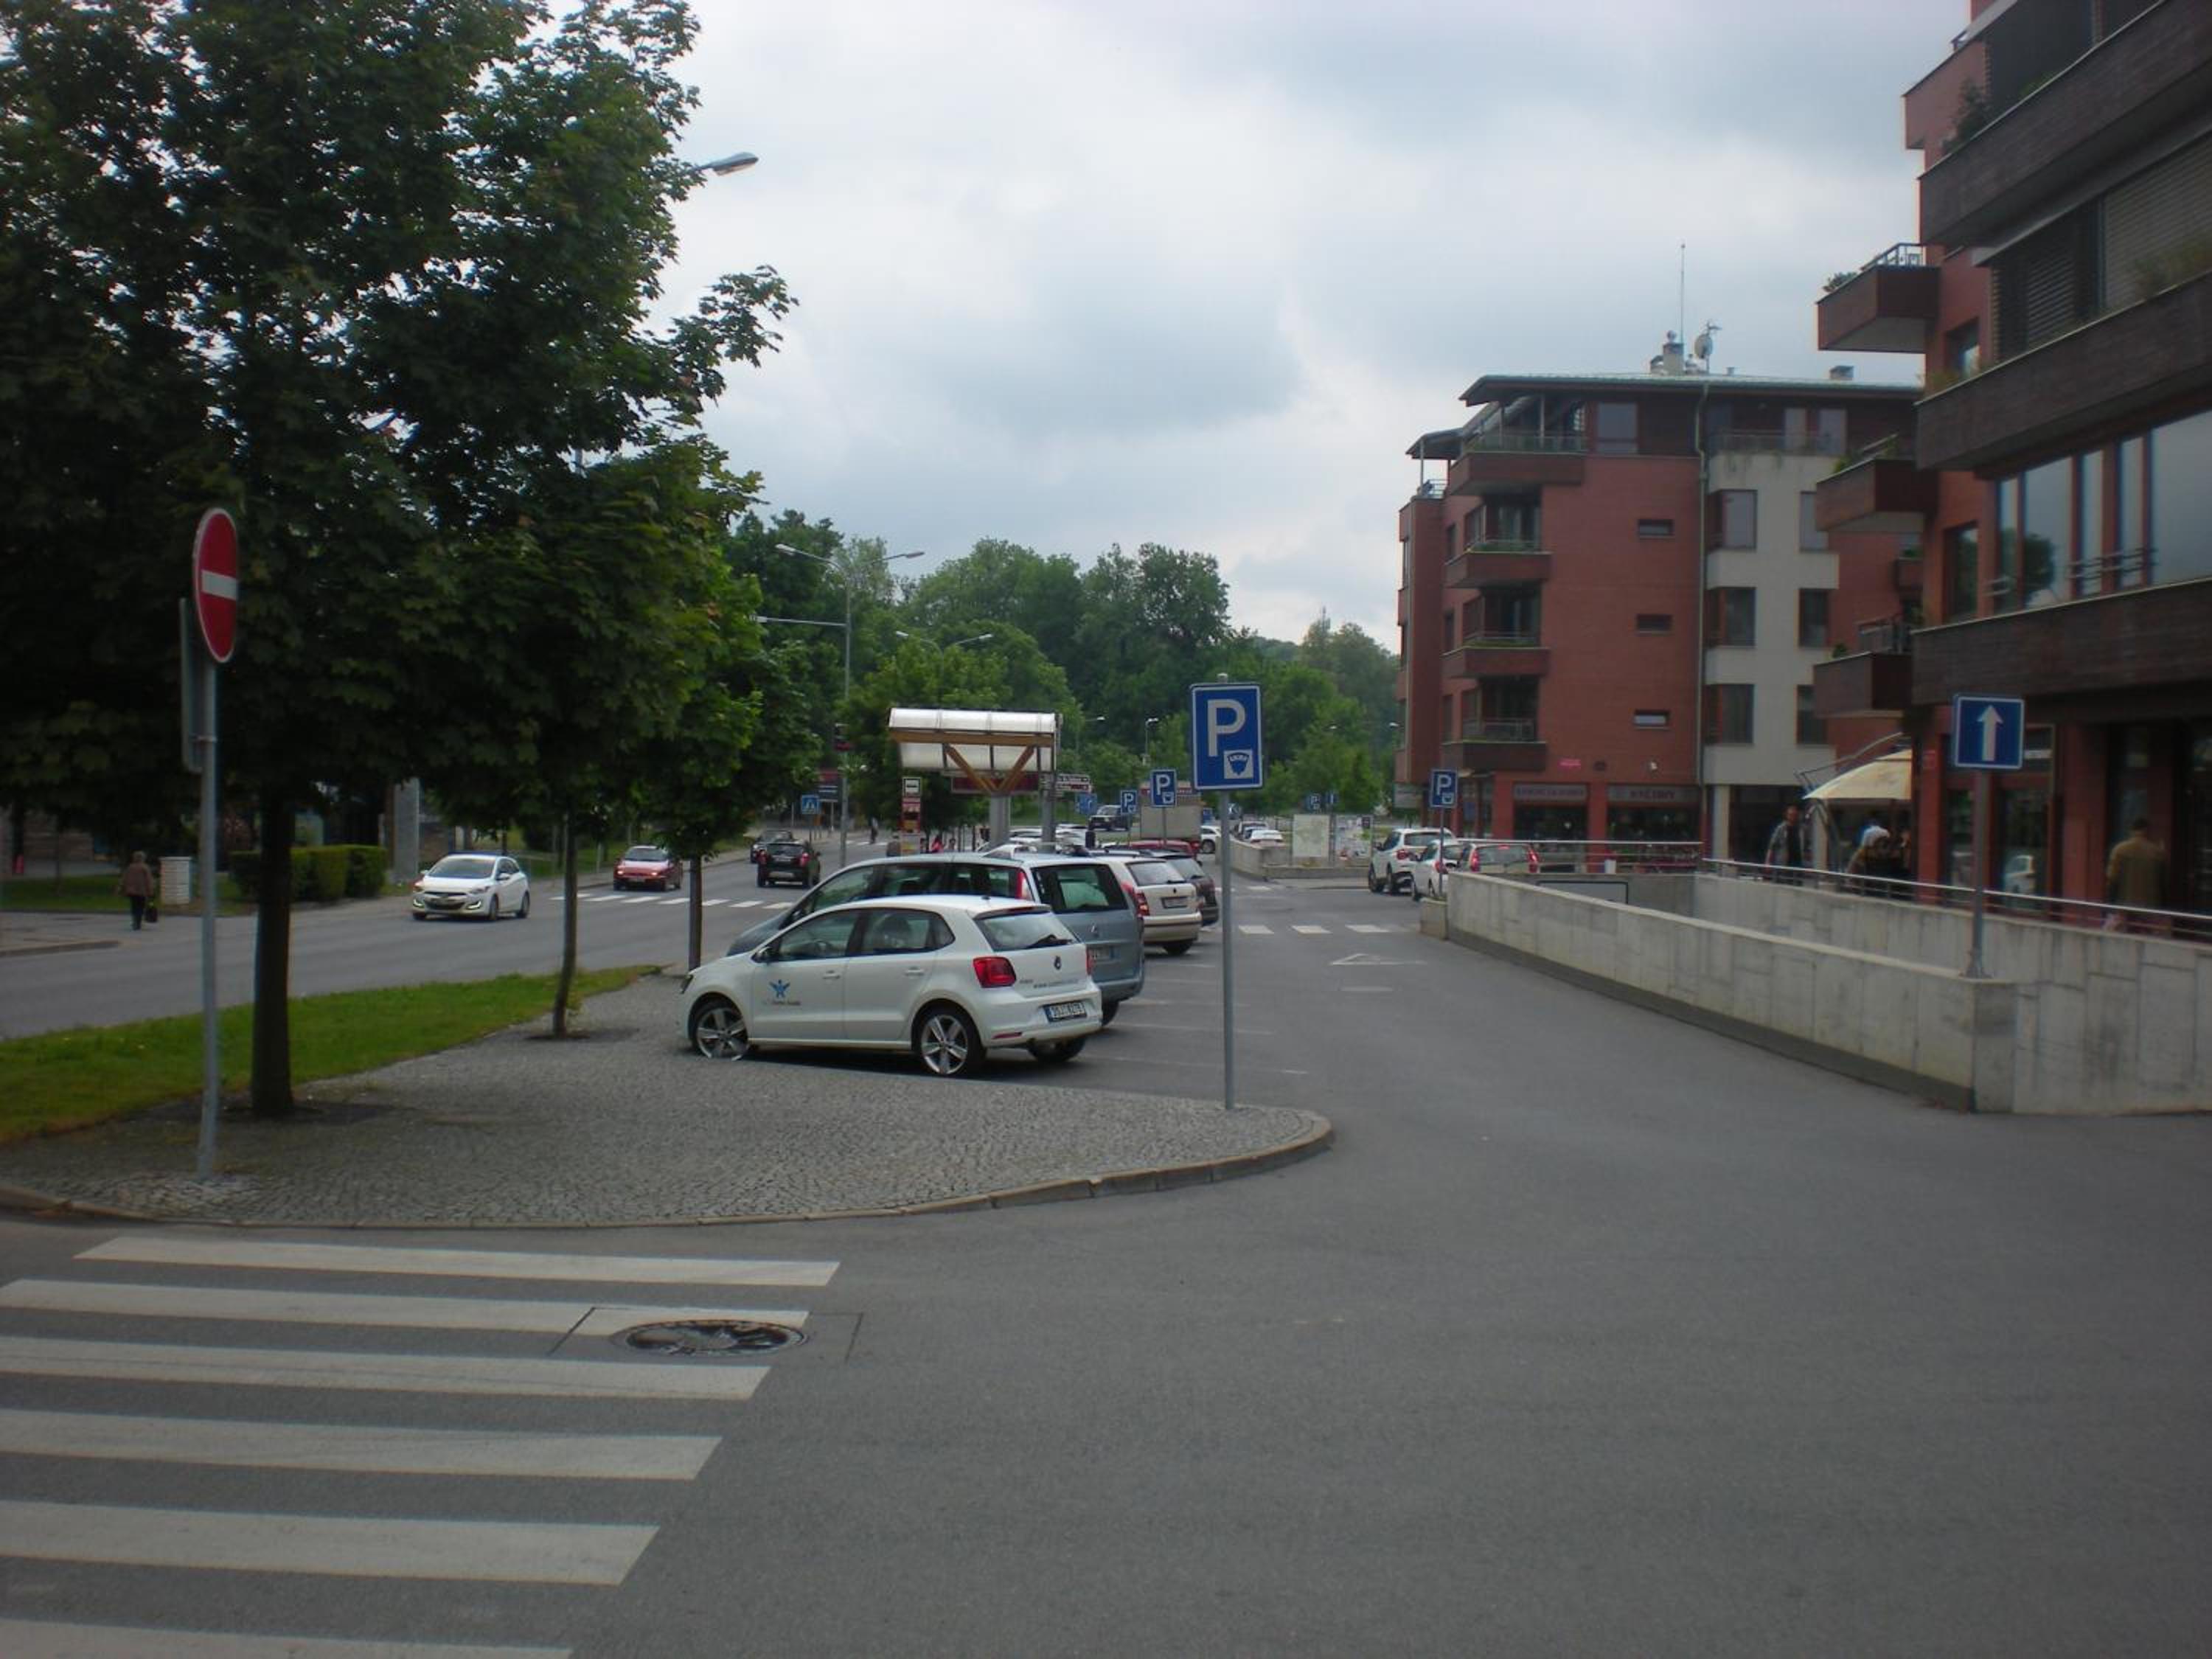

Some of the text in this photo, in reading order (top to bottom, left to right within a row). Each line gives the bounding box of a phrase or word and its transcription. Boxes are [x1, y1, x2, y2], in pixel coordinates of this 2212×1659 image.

[1207, 698, 1246, 757] P
[1155, 773, 1171, 796] P
[1437, 774, 1452, 795] P
[1124, 793, 1134, 807] P
